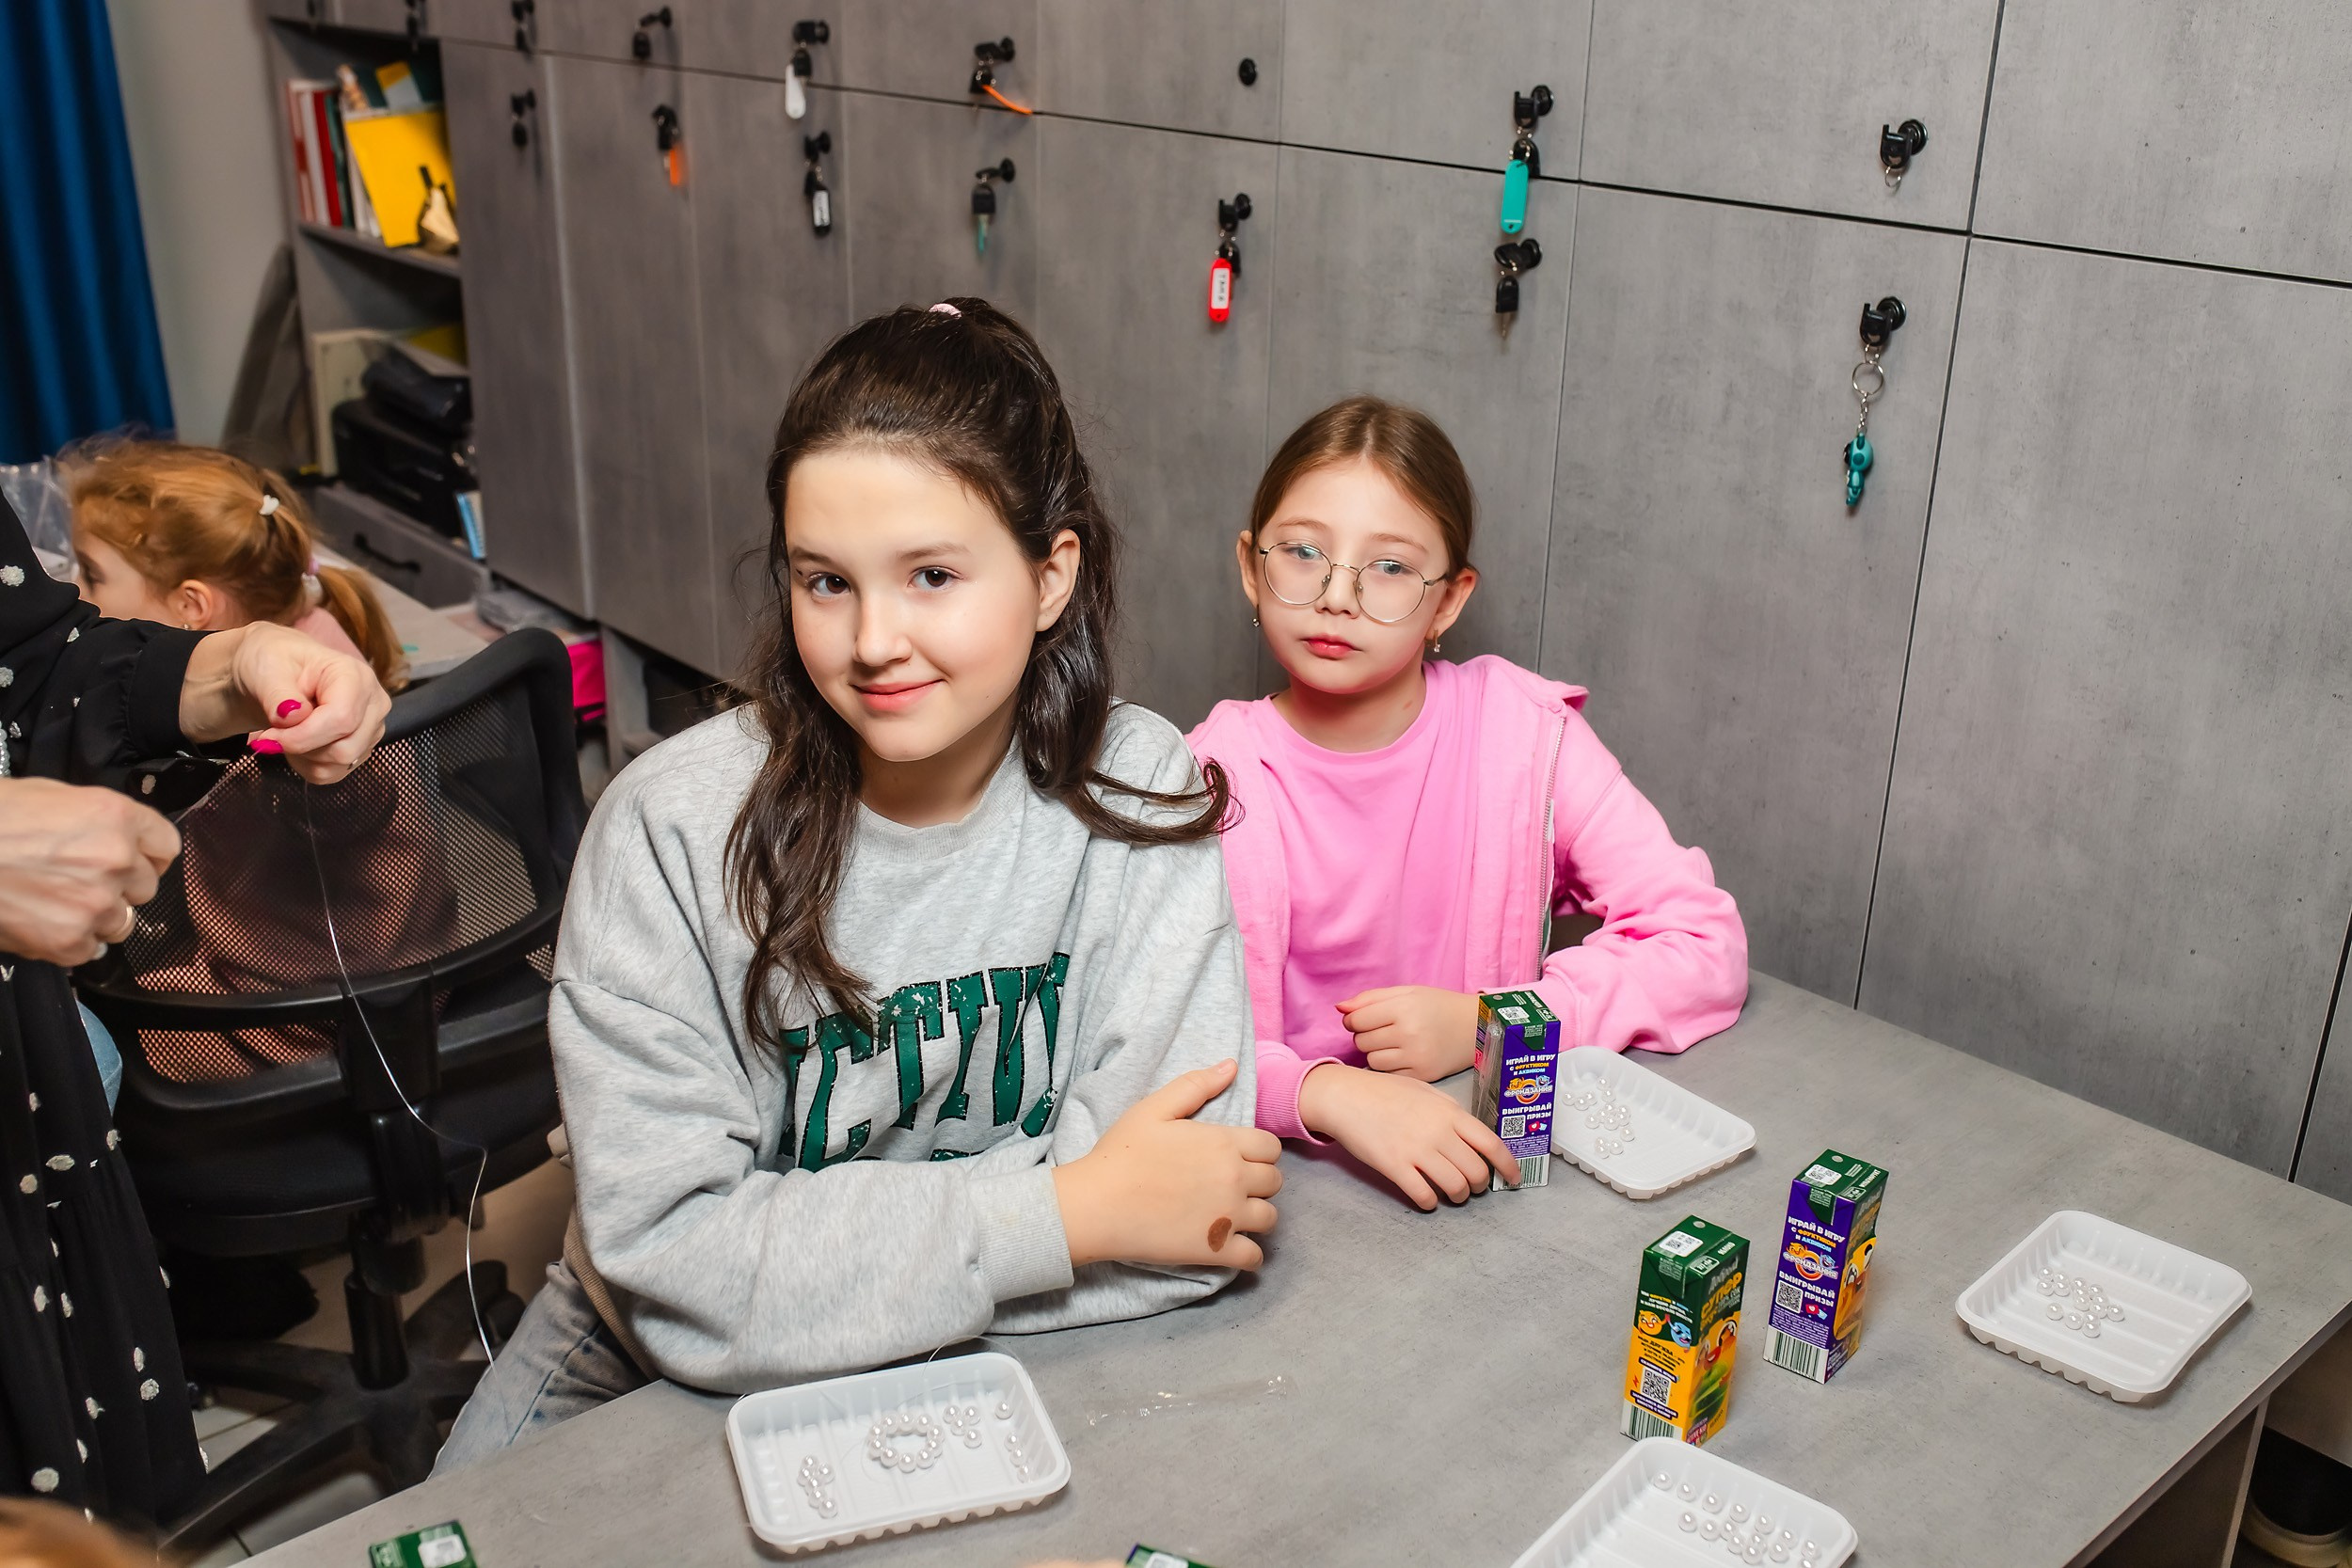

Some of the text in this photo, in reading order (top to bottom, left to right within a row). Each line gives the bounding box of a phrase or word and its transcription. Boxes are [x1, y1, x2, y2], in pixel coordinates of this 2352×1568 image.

[1505, 1054, 1529, 1066] ИГРАЙ
[1536, 1053, 1556, 1062] ИГРУ
[1502, 1102, 1552, 1116] ВЫИГРЫВАЙ
[1527, 1111, 1551, 1120] ПРИЗЫ
[1788, 1216, 1846, 1243] ИГРАЙ В ИГРУ
[1779, 1270, 1836, 1299] ВЫИГРЫВАЙ
[1804, 1291, 1835, 1307] ПРИЗЫ
